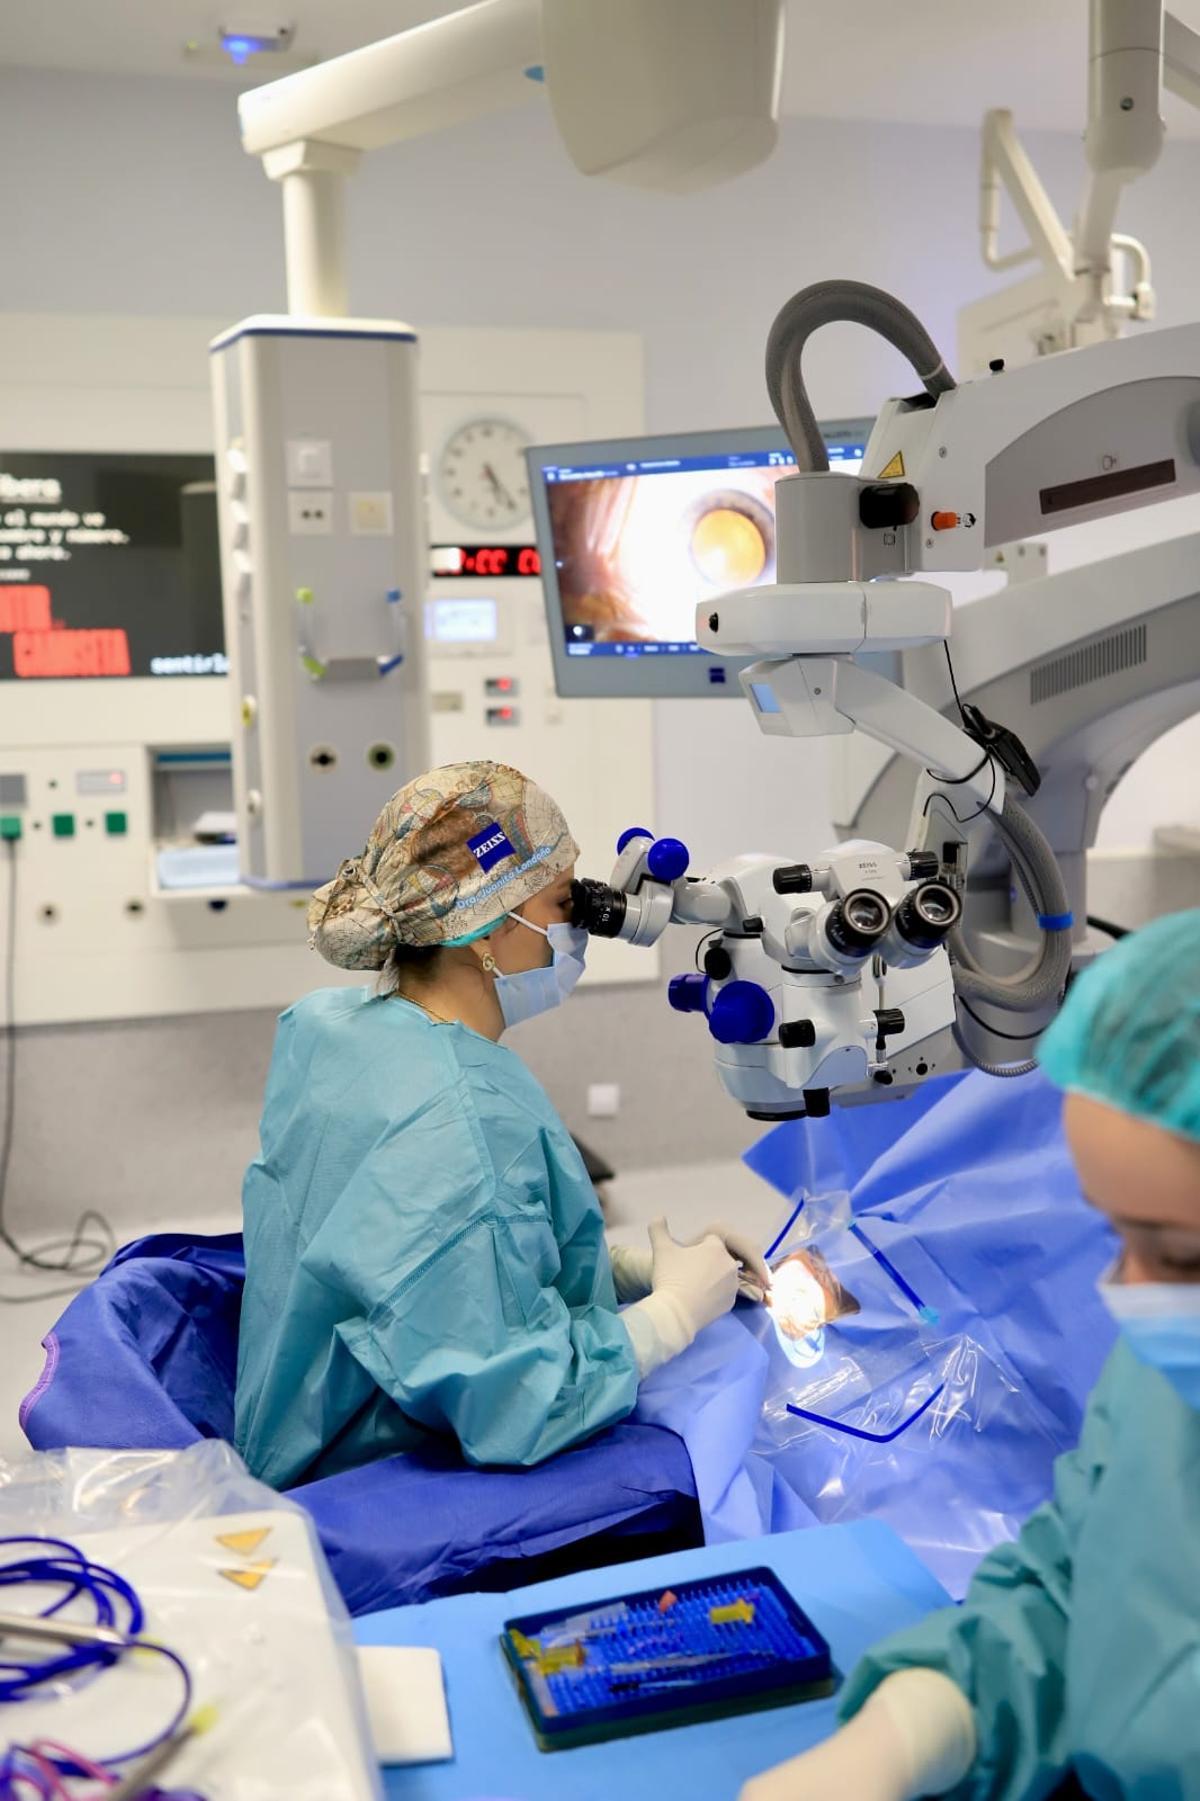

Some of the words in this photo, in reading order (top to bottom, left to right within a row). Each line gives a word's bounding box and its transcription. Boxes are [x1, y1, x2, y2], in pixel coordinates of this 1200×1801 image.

[473, 831, 506, 858] ZEISS
[481, 872, 515, 896] Juanita
[515, 846, 552, 873] Londoño
